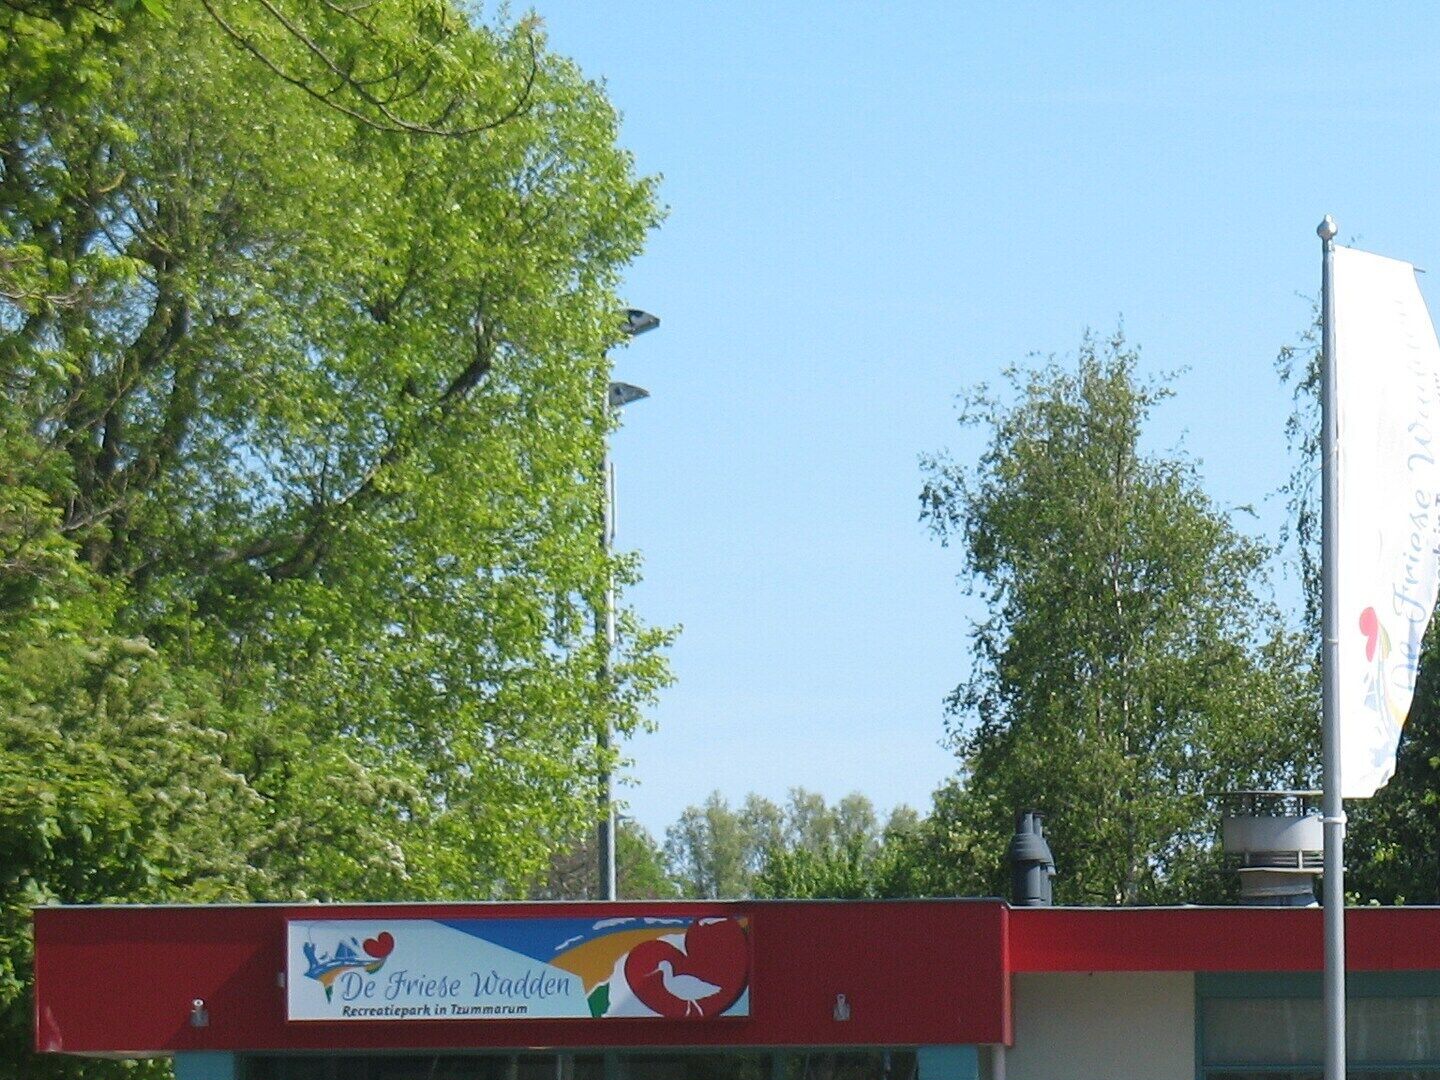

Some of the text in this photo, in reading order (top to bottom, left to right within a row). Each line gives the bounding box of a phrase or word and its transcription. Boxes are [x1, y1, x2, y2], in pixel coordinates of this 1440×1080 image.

[1392, 489, 1431, 623] Friese
[341, 969, 570, 1001] De Friese Wadden
[342, 1003, 528, 1018] Recreatiepark in Tzummarum
